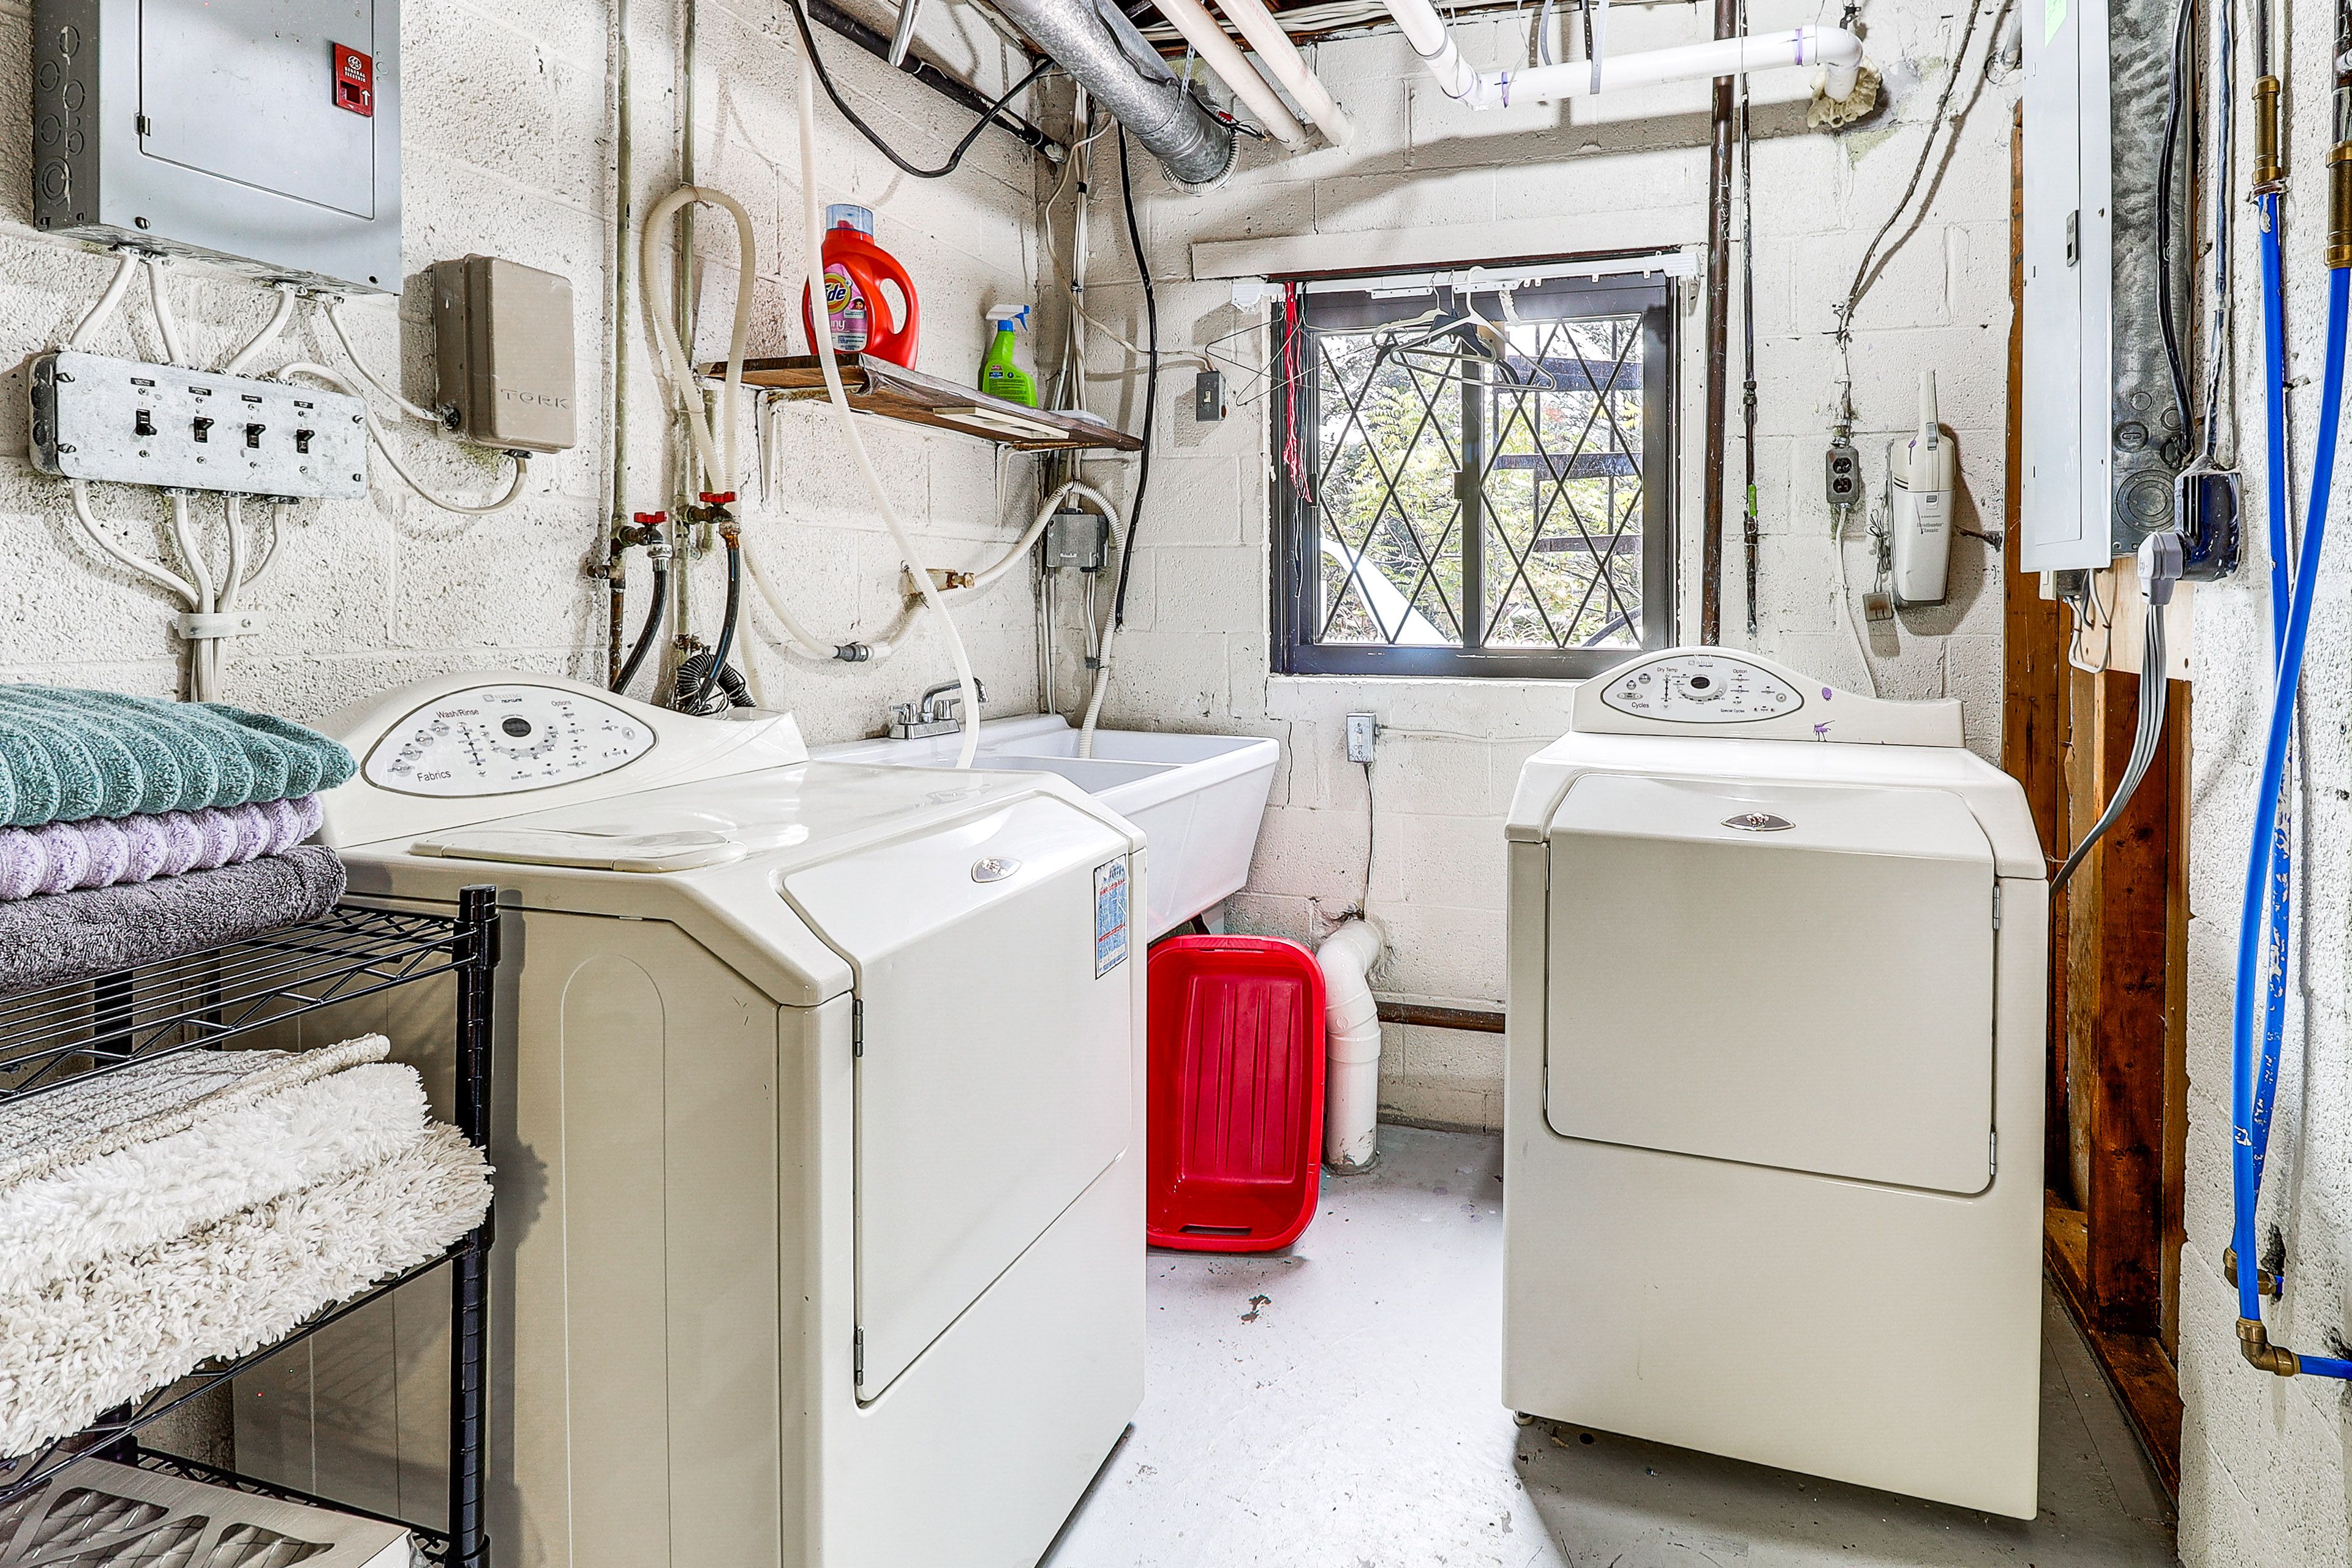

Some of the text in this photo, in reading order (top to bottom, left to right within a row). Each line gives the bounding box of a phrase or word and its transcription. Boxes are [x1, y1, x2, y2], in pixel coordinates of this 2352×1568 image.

[345, 71, 366, 83] ELECTRIC
[500, 388, 569, 409] TORK
[435, 709, 480, 718] Wash/Rinse
[417, 769, 451, 782] Fabrics
